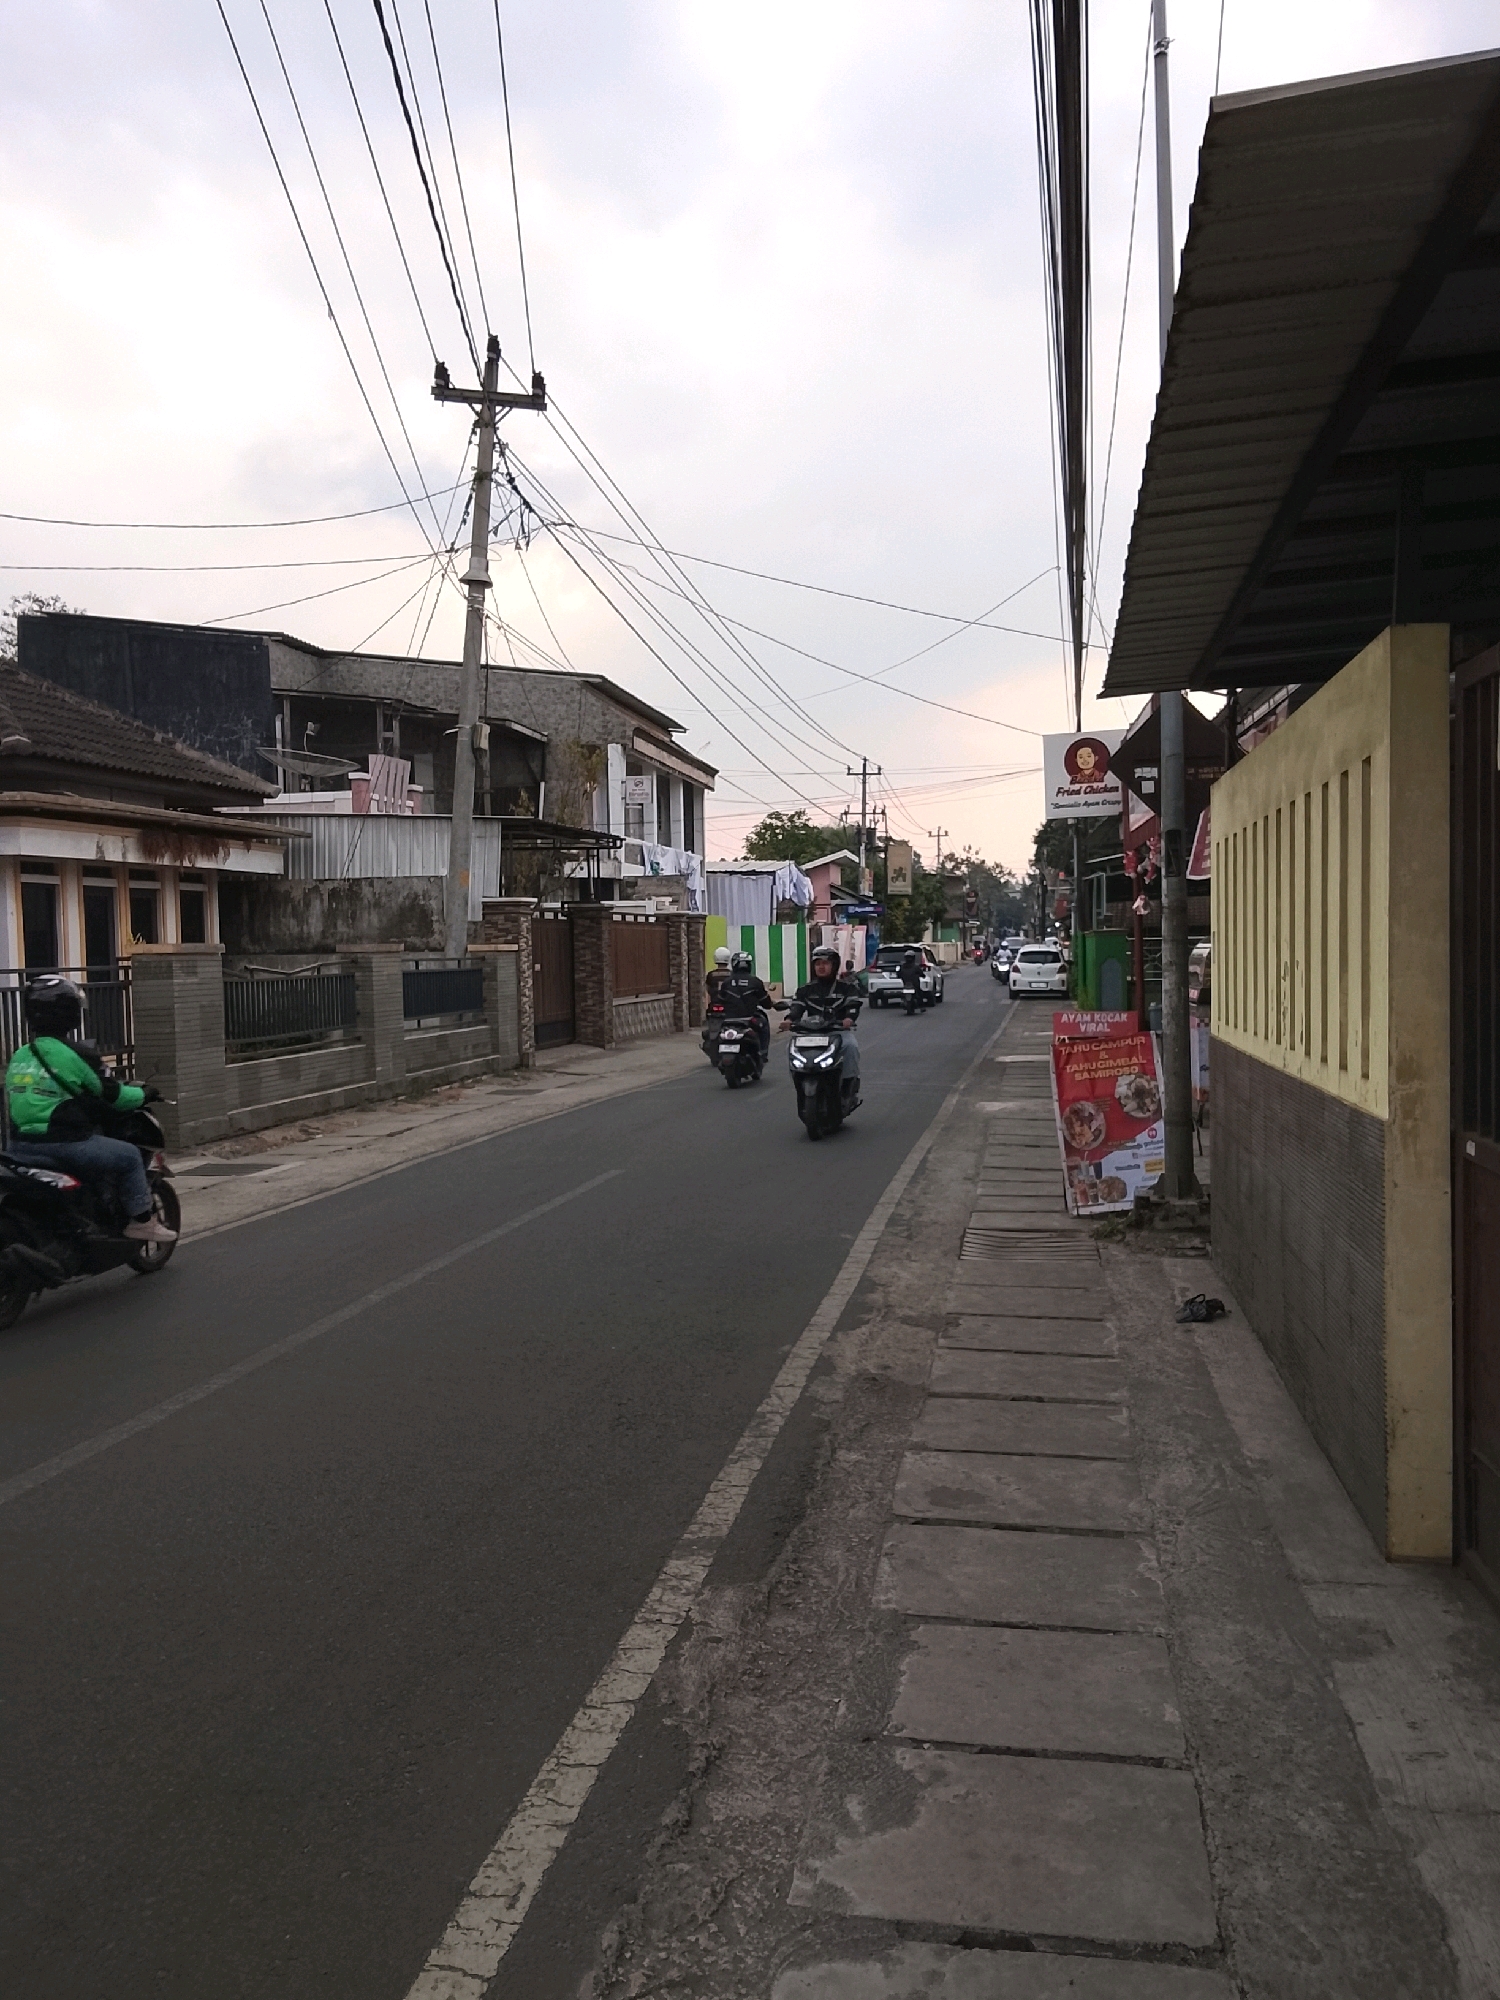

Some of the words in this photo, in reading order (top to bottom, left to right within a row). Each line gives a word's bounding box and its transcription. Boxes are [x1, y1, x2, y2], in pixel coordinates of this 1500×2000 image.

[1055, 786, 1082, 797] Fried
[1083, 784, 1119, 795] Chicken
[1061, 1013, 1091, 1023] AYAM
[1094, 1012, 1128, 1022] KOCAK
[1080, 1022, 1110, 1032] VIRAL
[1060, 1043, 1090, 1055] TAHU
[1091, 1036, 1146, 1051] CAMPUR
[1099, 1051, 1109, 1059] &
[1065, 1061, 1097, 1073] TAHU
[1097, 1055, 1147, 1069] GIMBAL
[1074, 1066, 1139, 1080] SAMIROSO
